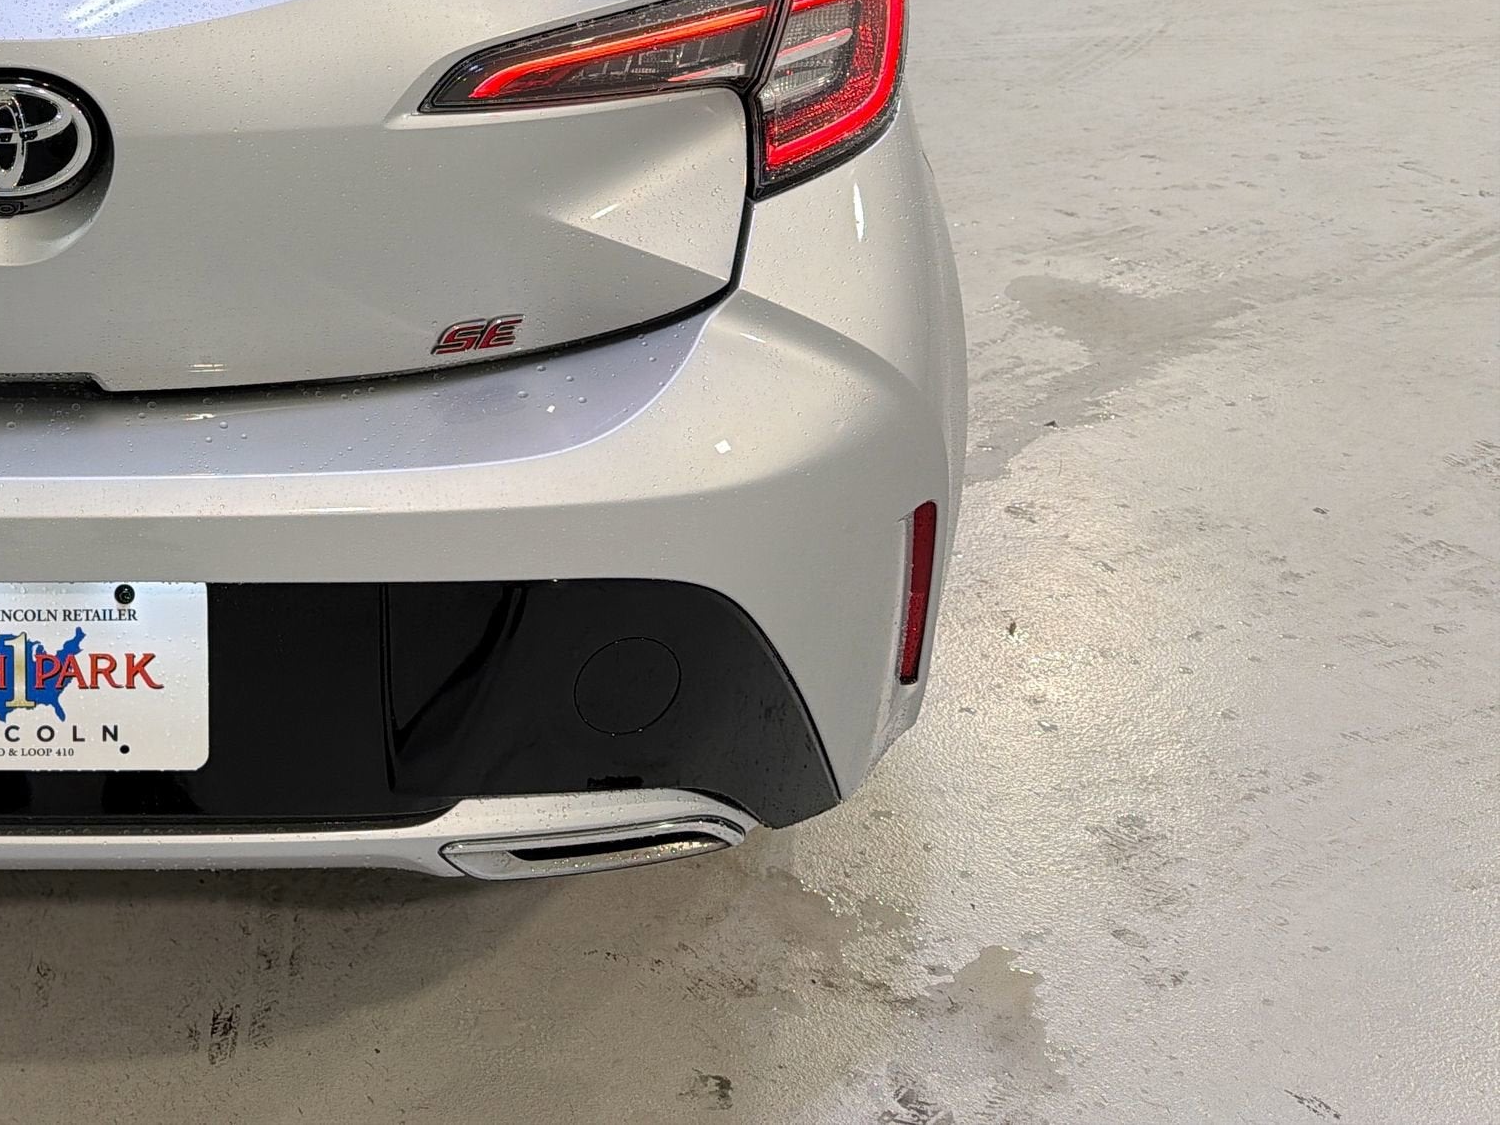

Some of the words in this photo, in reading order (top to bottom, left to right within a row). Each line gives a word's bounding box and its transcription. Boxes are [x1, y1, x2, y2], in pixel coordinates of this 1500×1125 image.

[430, 314, 525, 355] SE
[62, 608, 138, 622] RETAILER
[34, 653, 165, 691] PARK
[8, 747, 19, 757] &
[21, 747, 53, 757] LOOP
[55, 747, 75, 757] 410
